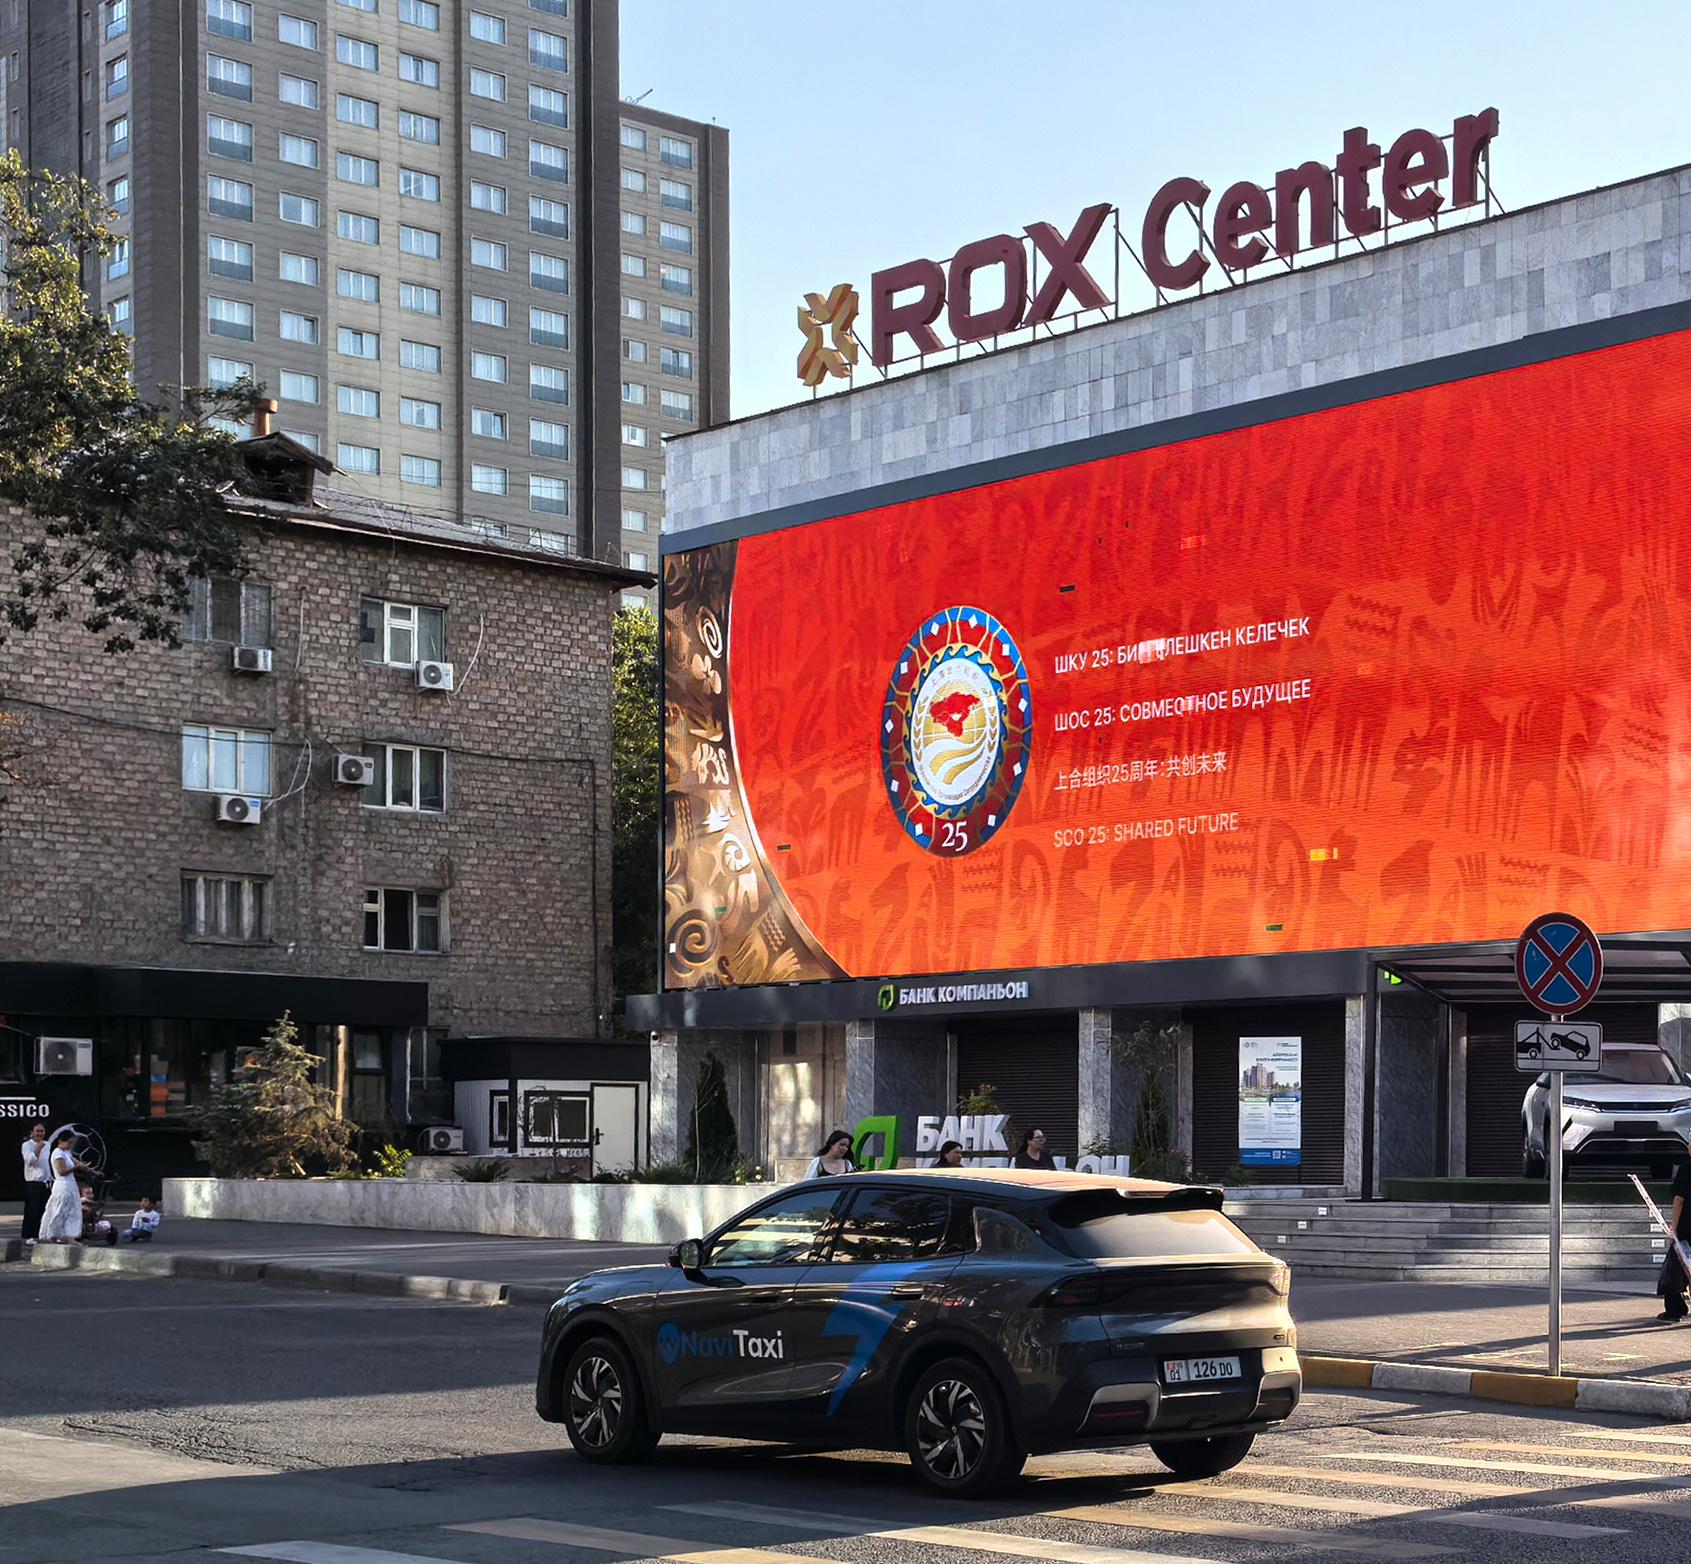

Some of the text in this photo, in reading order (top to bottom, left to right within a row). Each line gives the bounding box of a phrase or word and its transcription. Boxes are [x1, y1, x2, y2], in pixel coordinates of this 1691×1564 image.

[871, 106, 1500, 367] ROX Center
[1055, 617, 1309, 674] ШКУ 25: БИЛЕШКЕН КЕЛЕЧЕК
[1055, 710, 1090, 732] ШОС
[1094, 706, 1116, 727] 25:
[1232, 678, 1311, 709] БУДУЩЕЕ
[941, 821, 968, 852] 25
[1053, 812, 1239, 848] SCO 25: SHARED FUTURE
[900, 981, 1028, 1005] БАНК КОМПАНЬОН
[916, 1114, 1009, 1152] БАНК
[1193, 1360, 1217, 1378] 126
